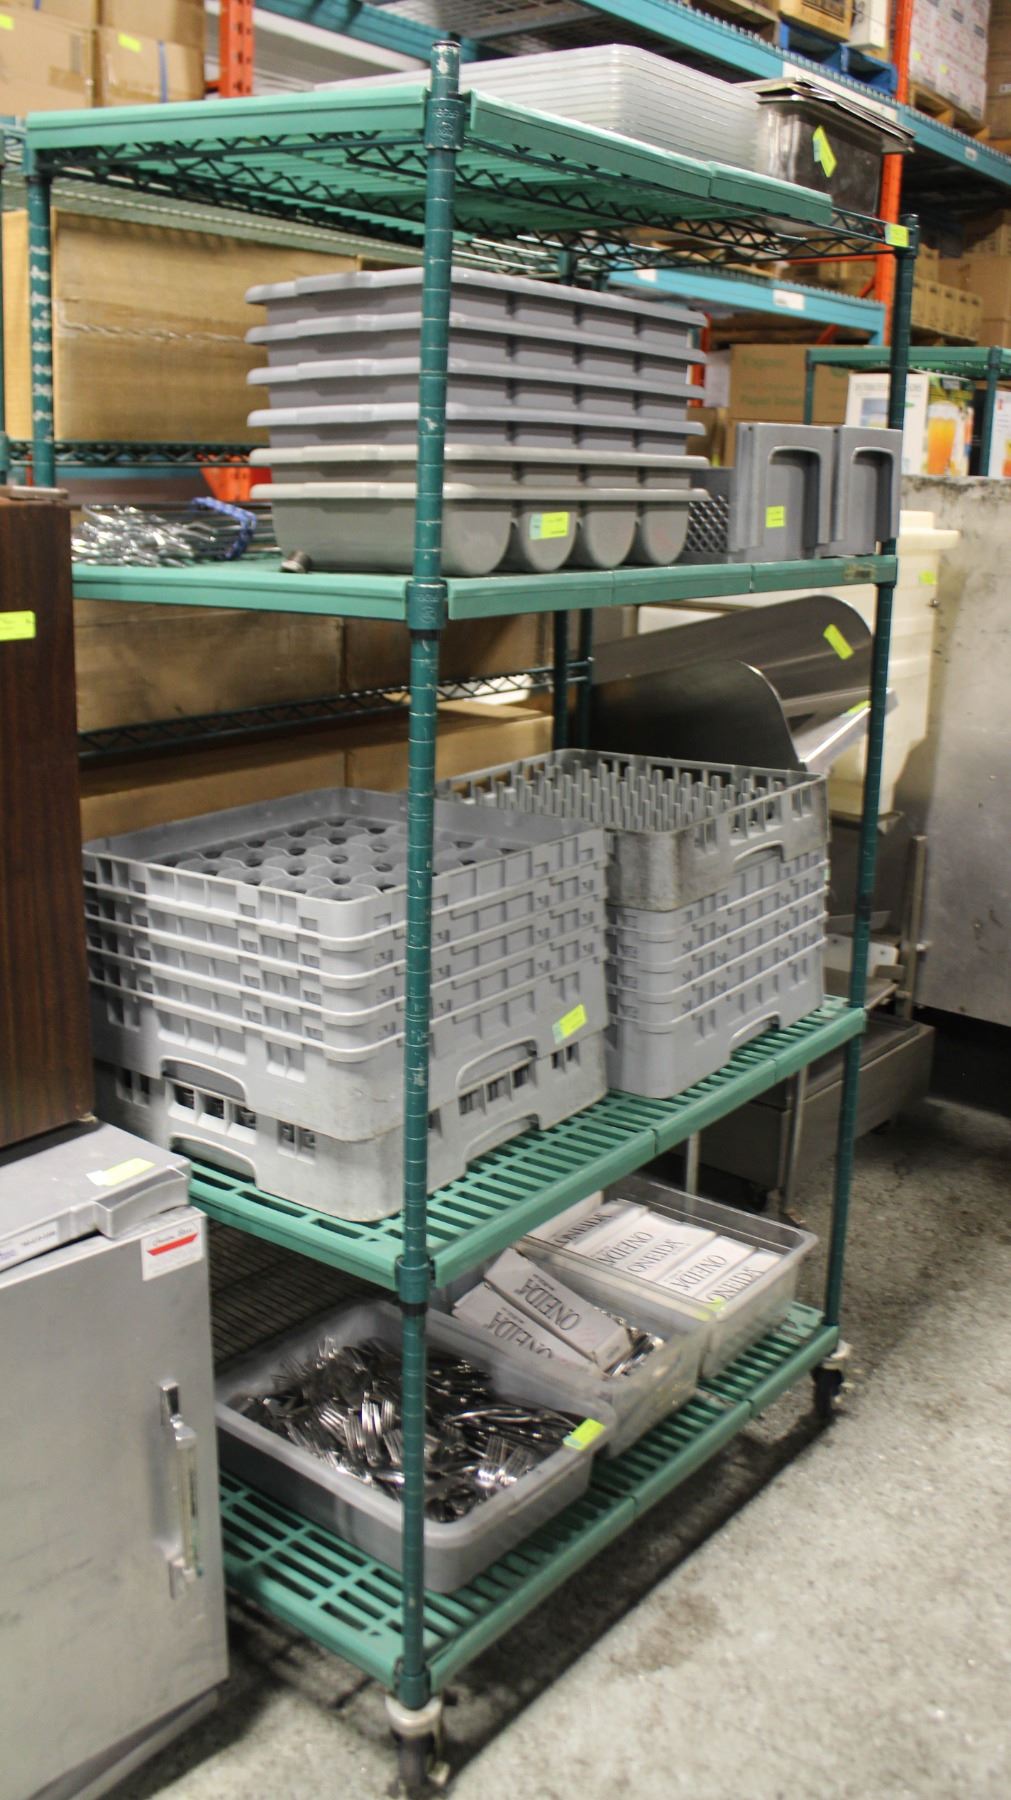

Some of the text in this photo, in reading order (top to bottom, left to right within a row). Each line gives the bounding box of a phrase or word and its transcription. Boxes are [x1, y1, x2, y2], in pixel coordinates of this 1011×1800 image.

[627, 1239, 684, 1274] ONEIDA
[670, 1254, 728, 1291] ONEIDA
[514, 1278, 581, 1331] ONEIDA
